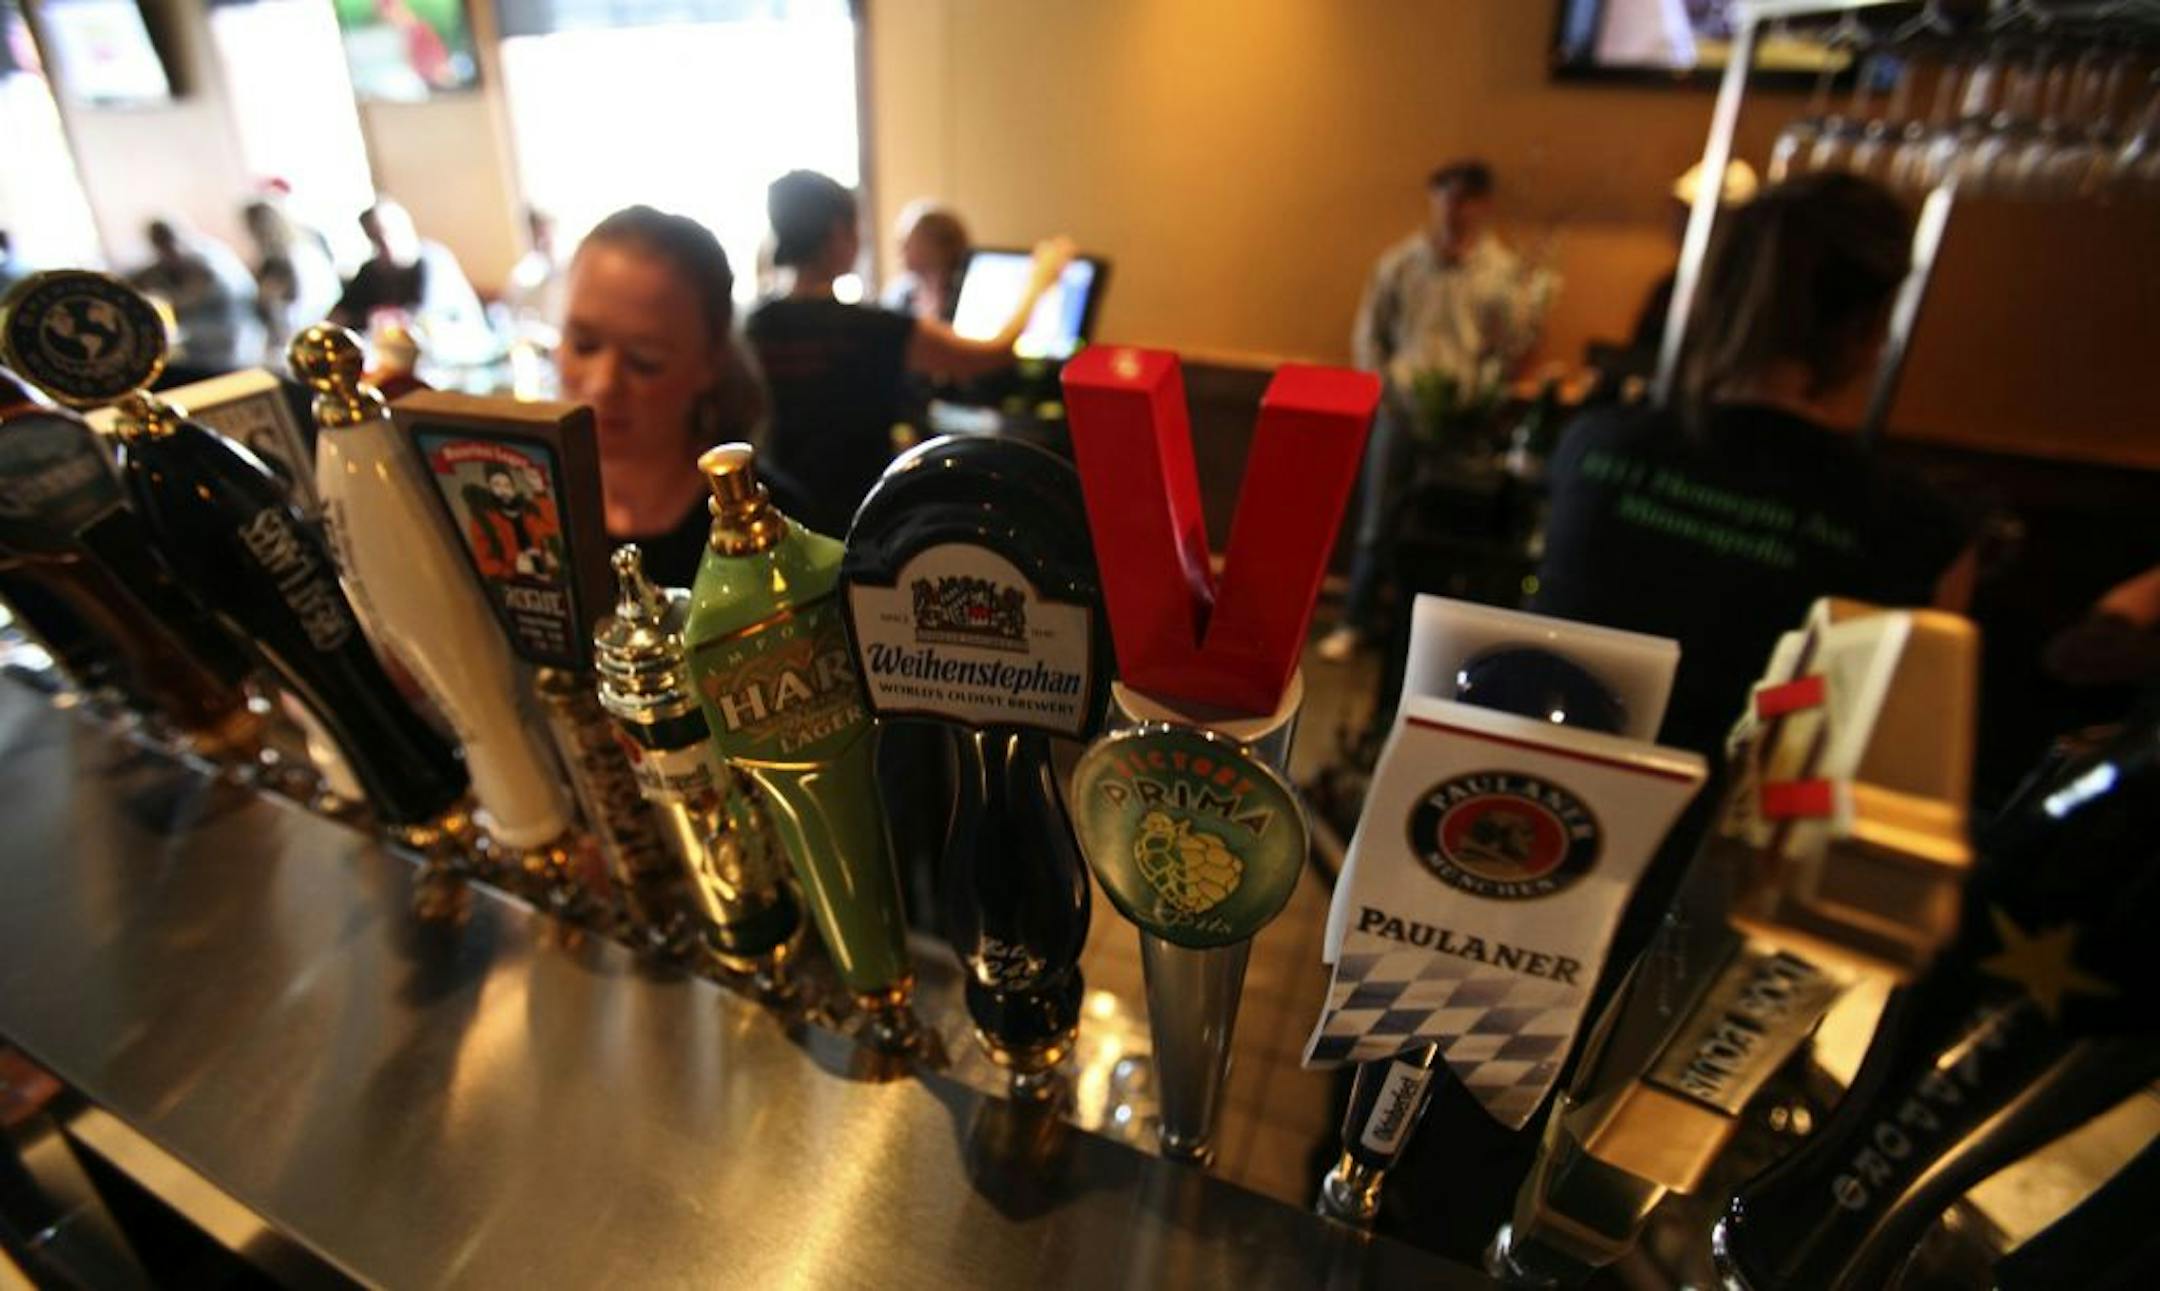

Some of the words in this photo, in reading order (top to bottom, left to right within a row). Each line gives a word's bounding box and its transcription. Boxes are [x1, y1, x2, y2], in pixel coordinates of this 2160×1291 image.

[720, 651, 856, 732] HAR
[867, 641, 1082, 695] Weihenstephan
[1101, 775, 1277, 840] PRIMA
[1356, 905, 1583, 987] PAULANER
